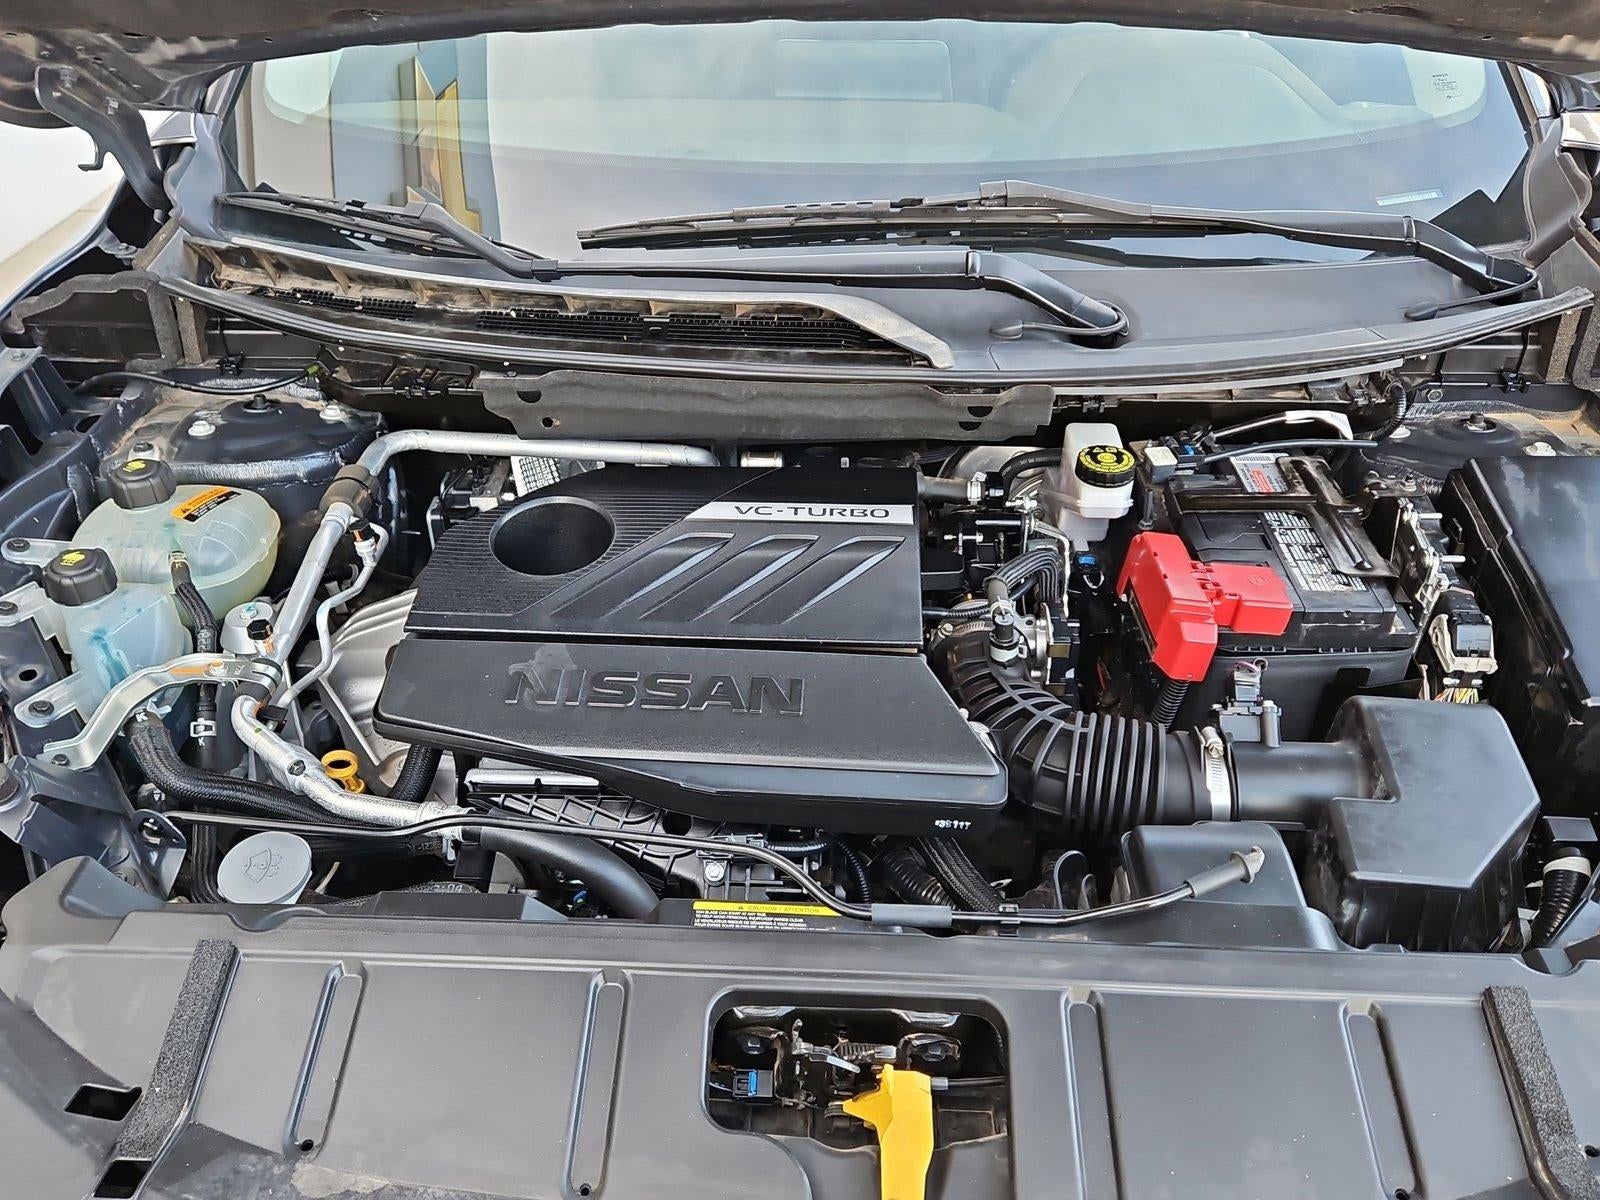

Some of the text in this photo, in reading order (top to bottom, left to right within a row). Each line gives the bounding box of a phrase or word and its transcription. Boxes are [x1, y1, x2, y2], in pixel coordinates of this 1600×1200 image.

[734, 505, 890, 519] VC-TURBO
[504, 669, 804, 716] NISSAN
[784, 906, 820, 914] ATTENTION
